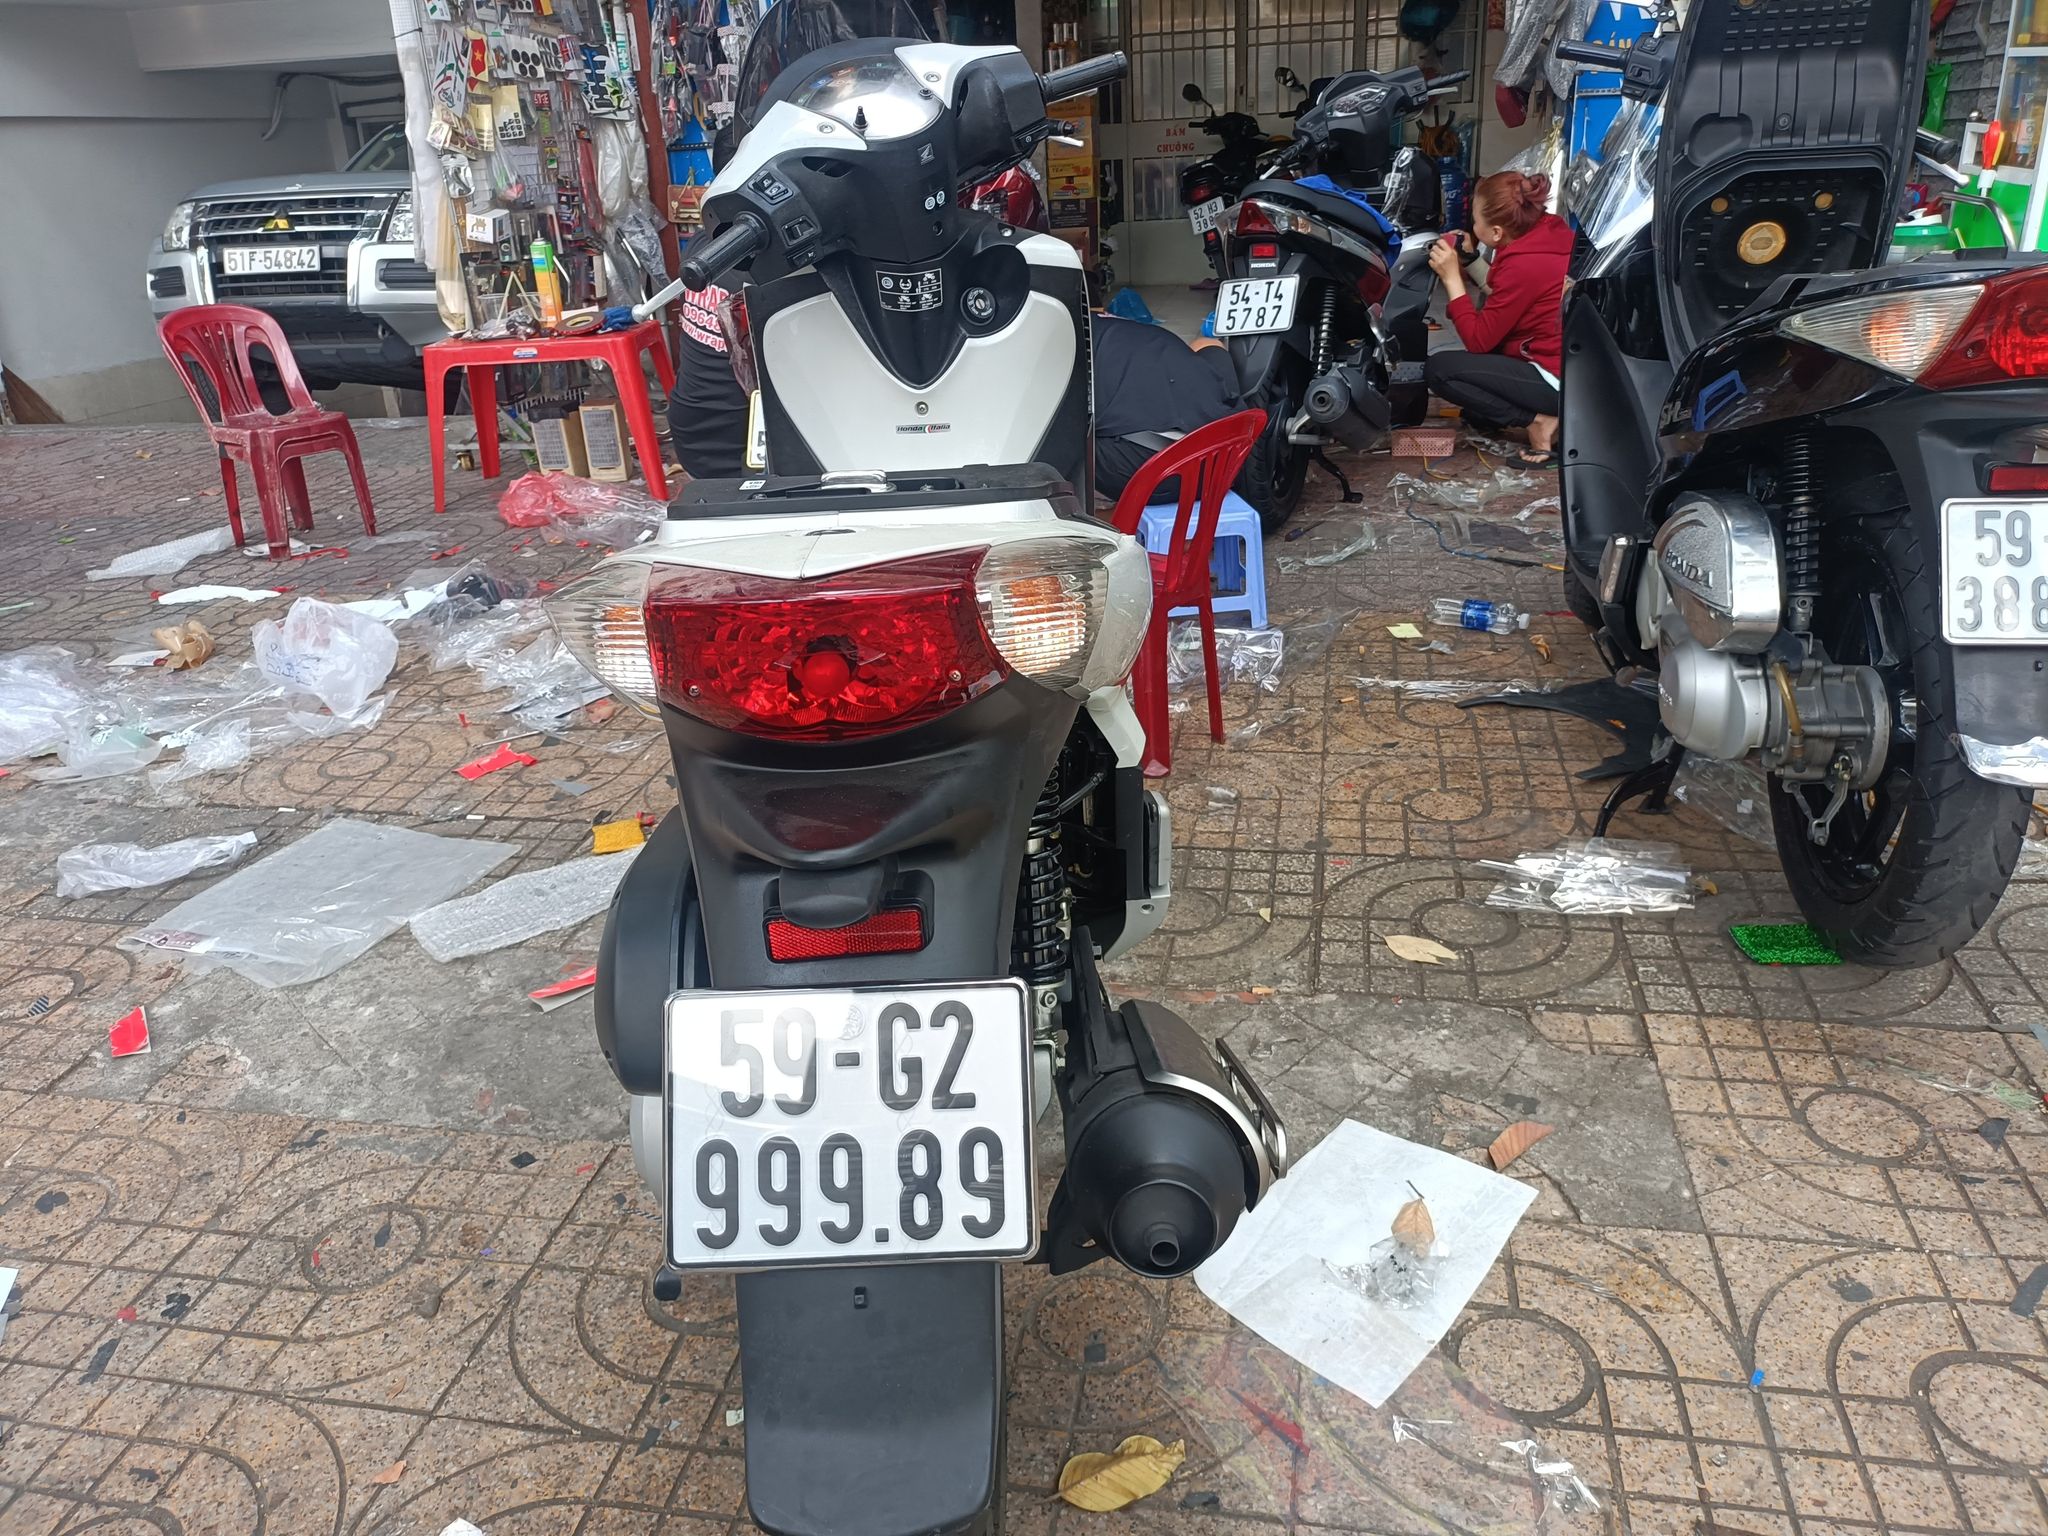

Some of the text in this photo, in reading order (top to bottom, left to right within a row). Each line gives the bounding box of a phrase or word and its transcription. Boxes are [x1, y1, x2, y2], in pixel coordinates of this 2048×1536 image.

[1193, 207, 1205, 220] 52
[1196, 212, 1220, 232] 388
[227, 248, 316, 272] 51F-548.42
[1229, 279, 1284, 306] 54-T4
[1225, 304, 1283, 331] 5787
[720, 1000, 977, 1118] 59-G2
[695, 1125, 1006, 1250] 999.89
